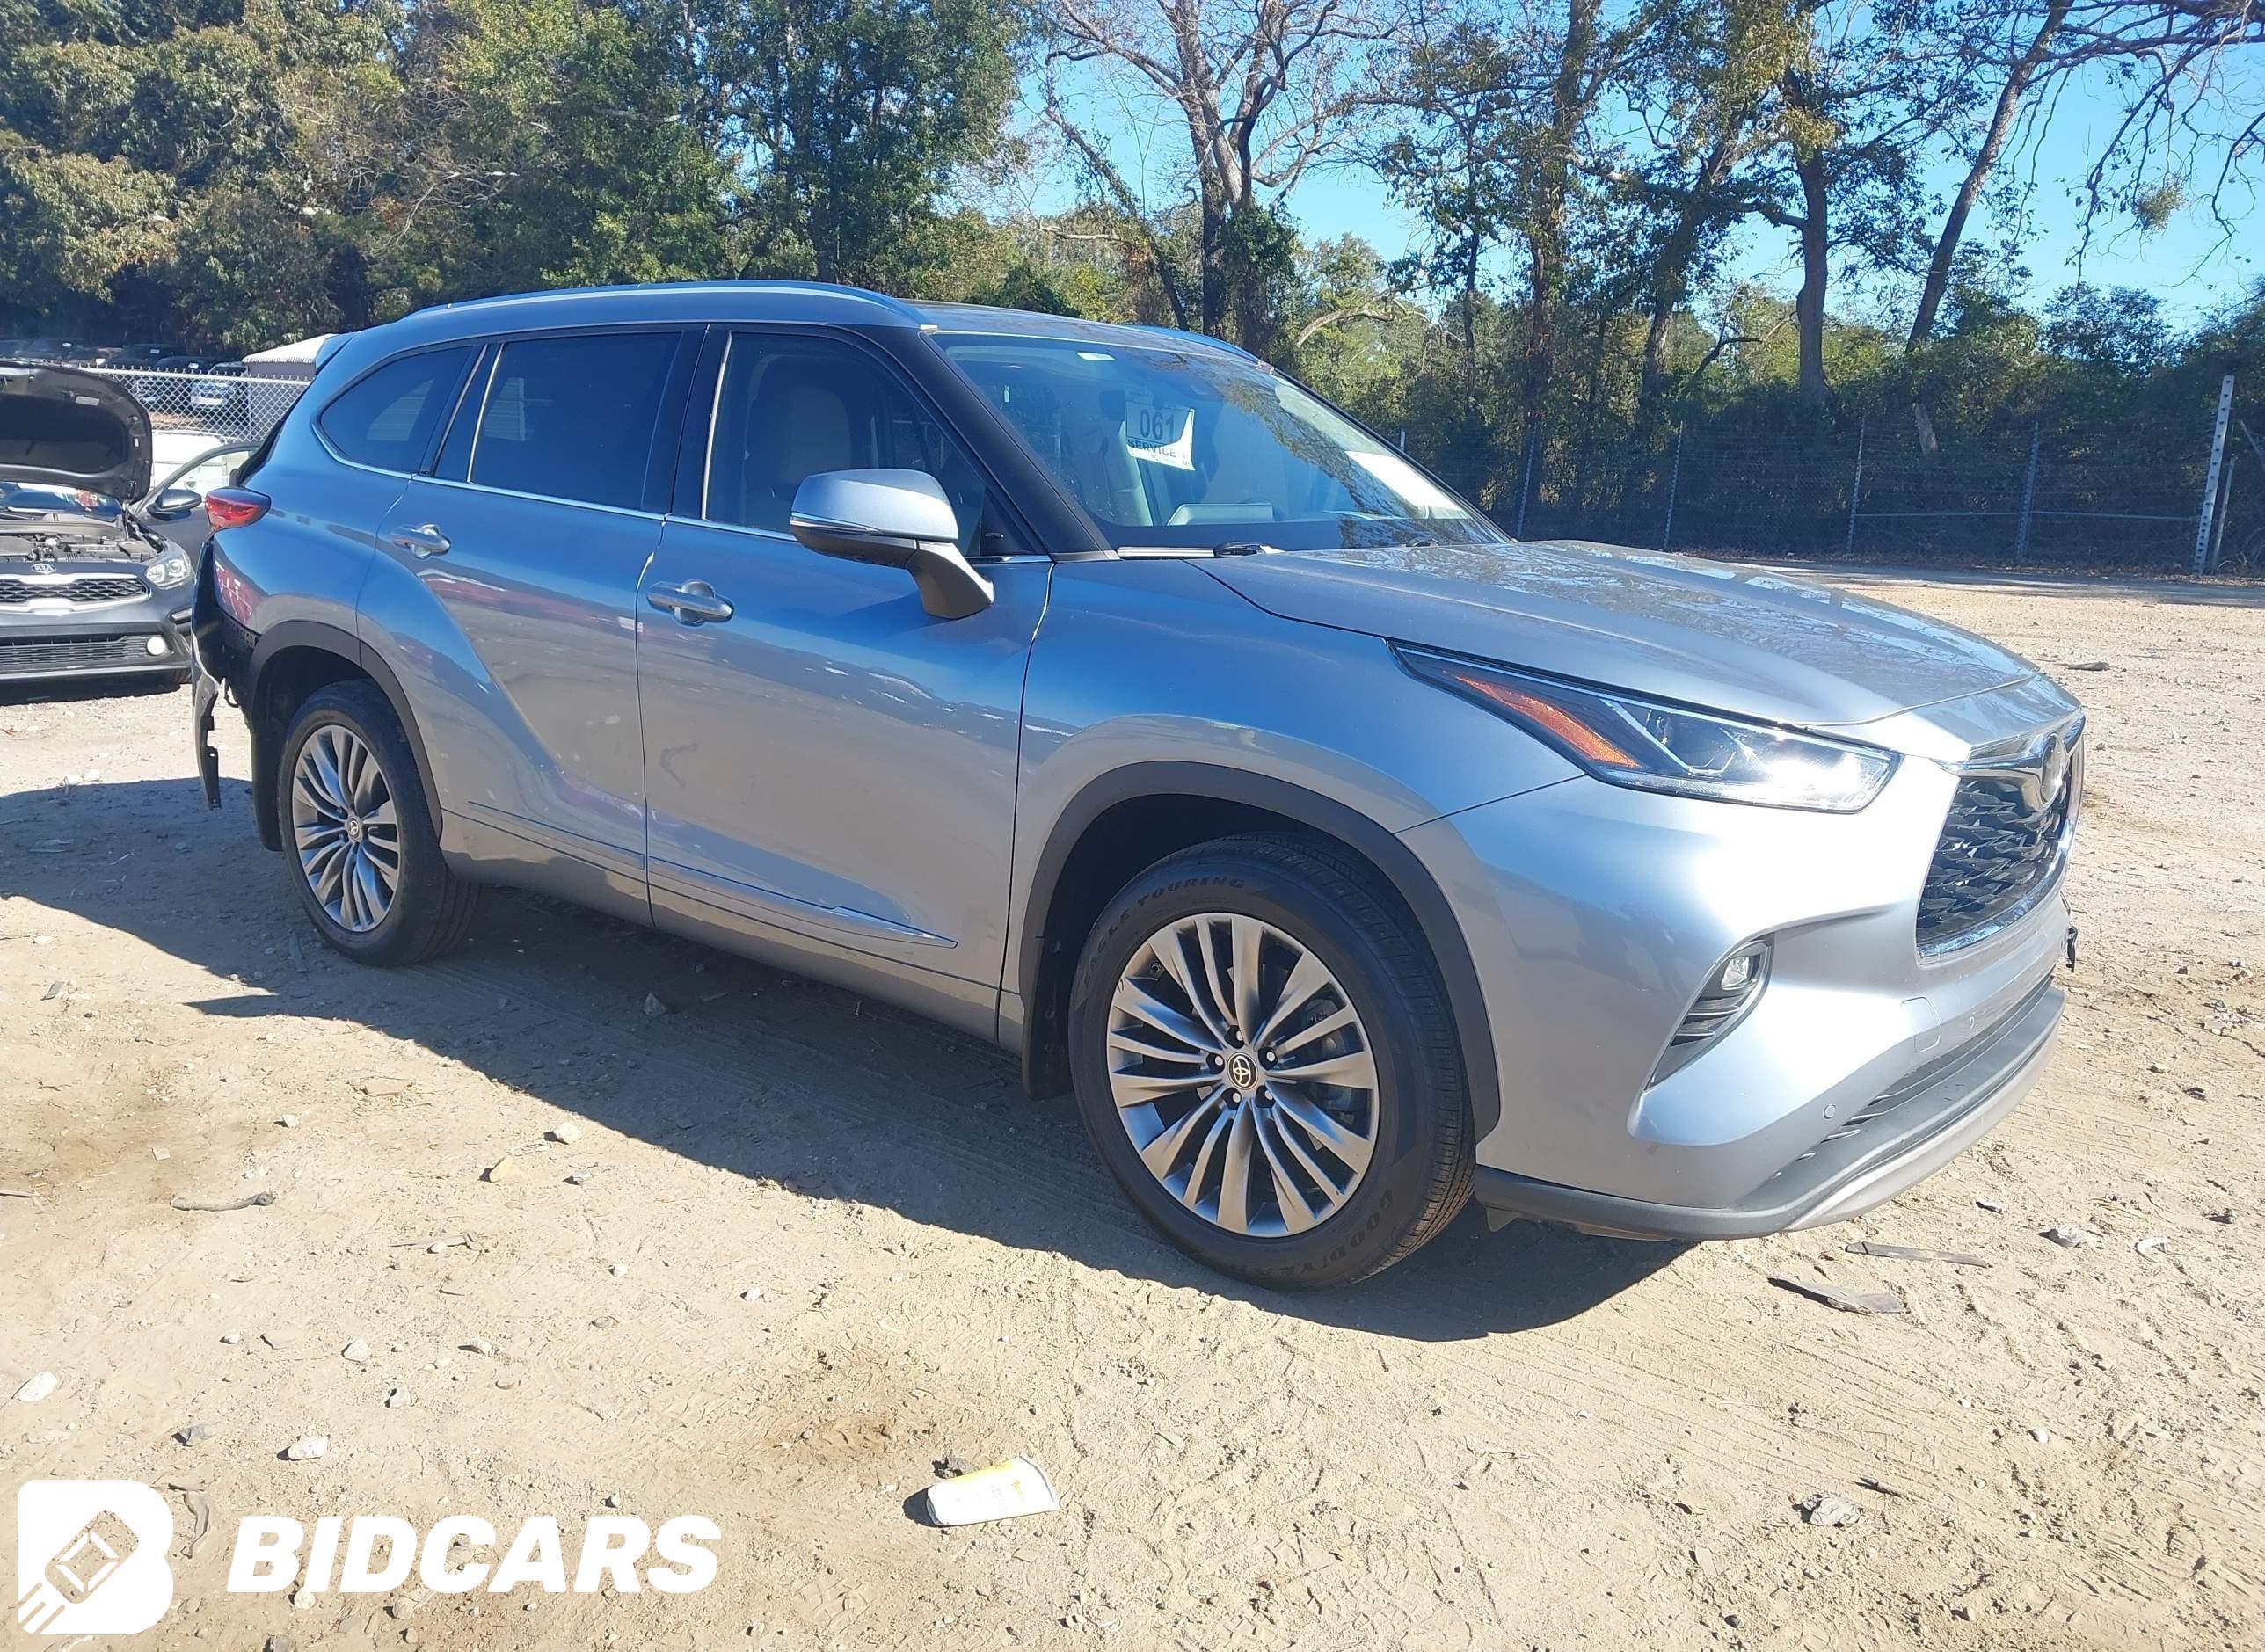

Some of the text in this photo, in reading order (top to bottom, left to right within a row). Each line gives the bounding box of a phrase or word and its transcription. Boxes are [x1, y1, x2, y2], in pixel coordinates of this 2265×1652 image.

[1139, 408, 1175, 443] 061
[1127, 439, 1176, 458] SERVICE
[1137, 877, 1246, 908] TOURING
